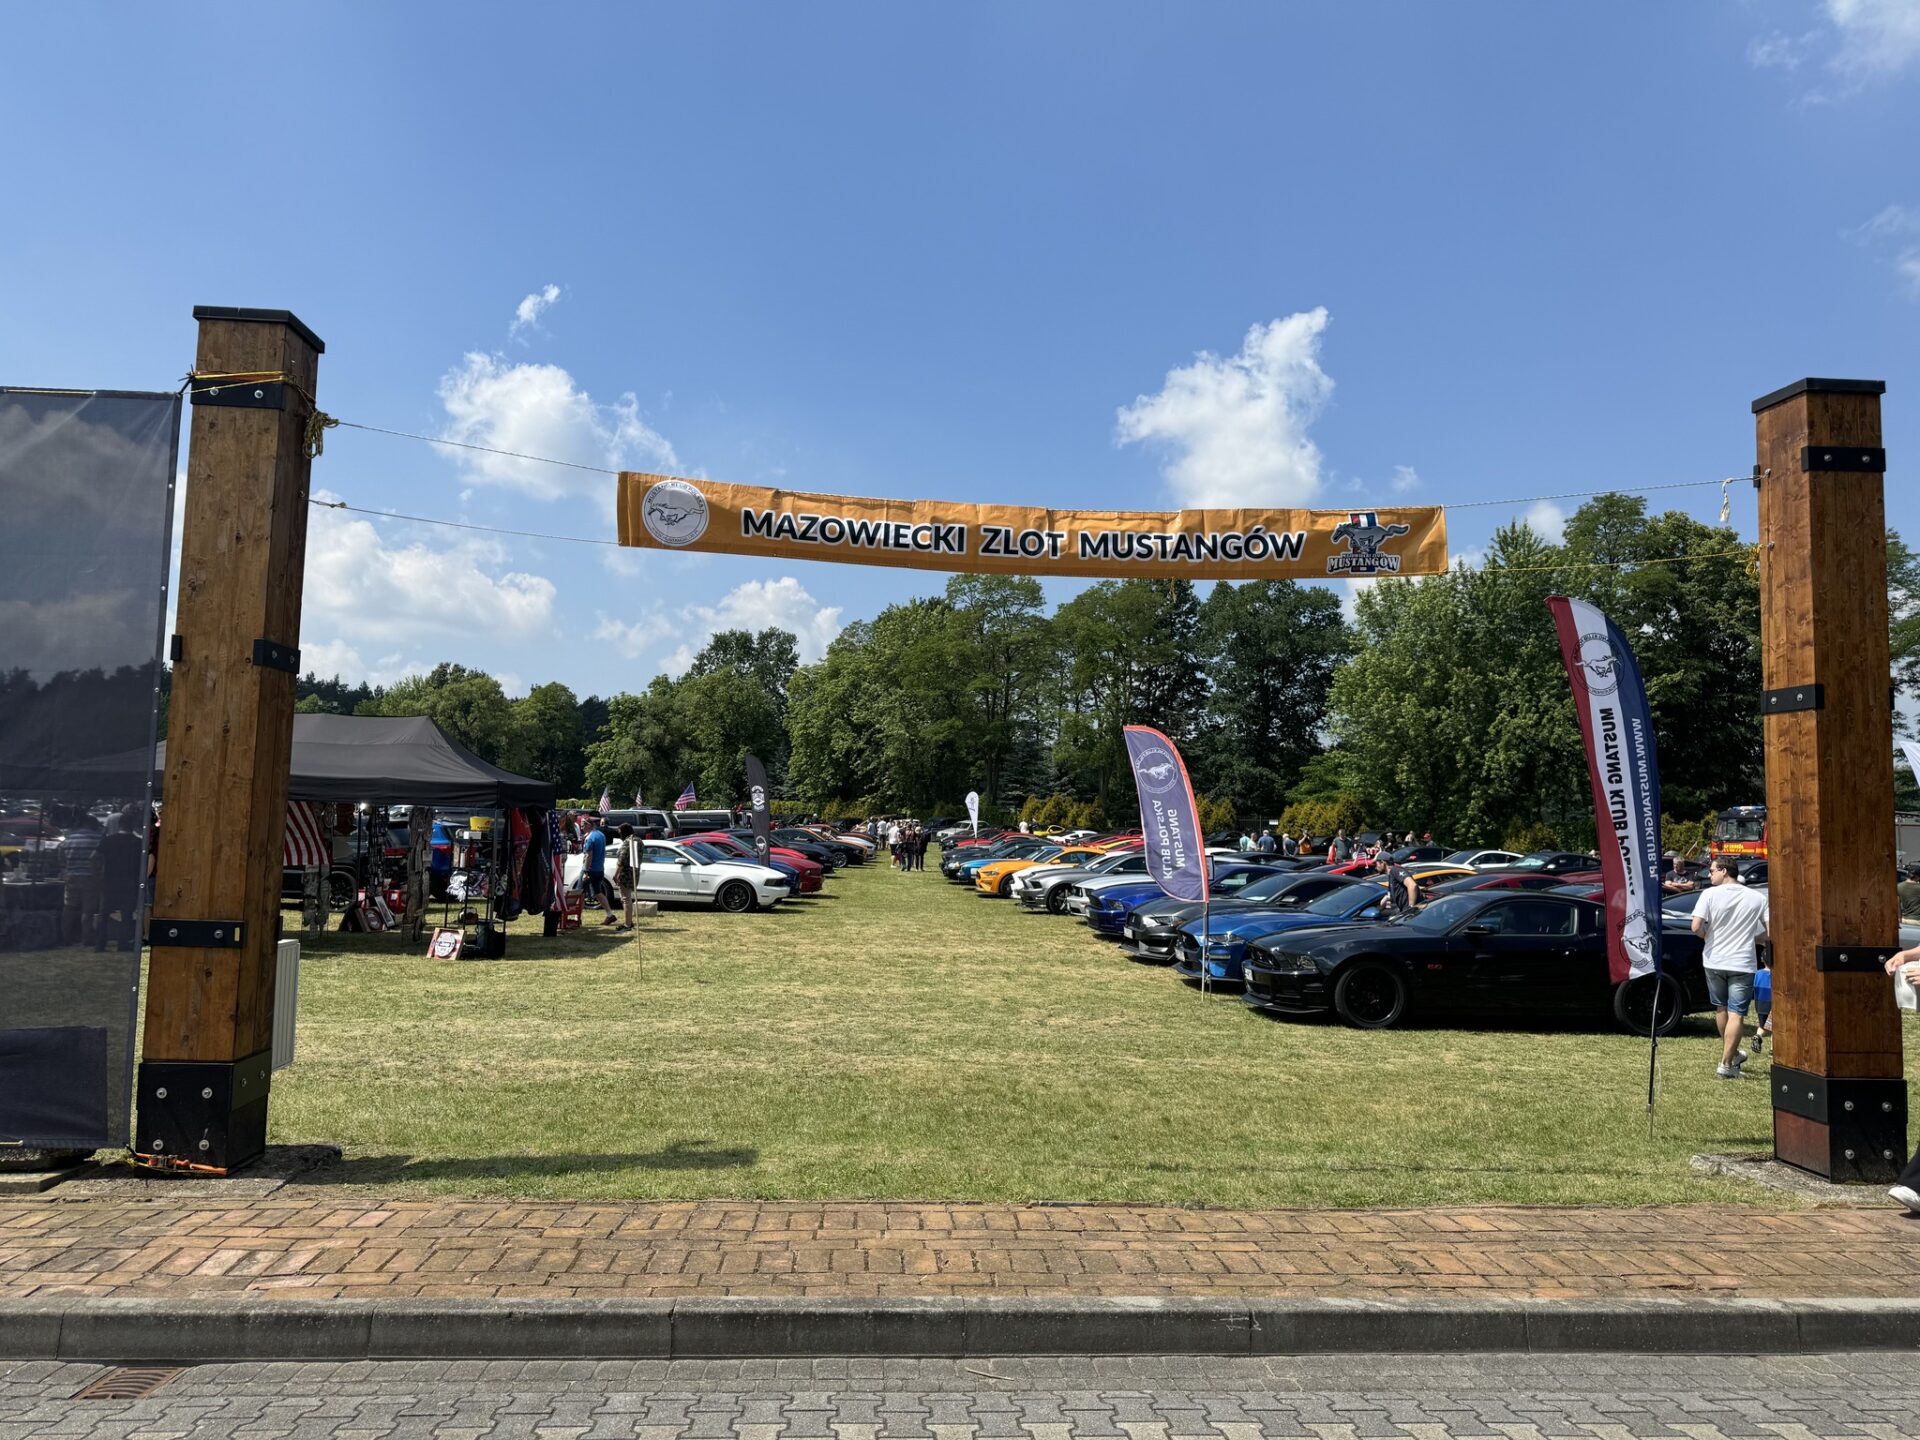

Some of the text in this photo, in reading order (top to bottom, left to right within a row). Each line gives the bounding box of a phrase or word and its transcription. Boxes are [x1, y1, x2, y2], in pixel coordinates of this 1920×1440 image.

[742, 508, 1306, 562] MAZOWIECKI ZLOT MUSTANGÓW
